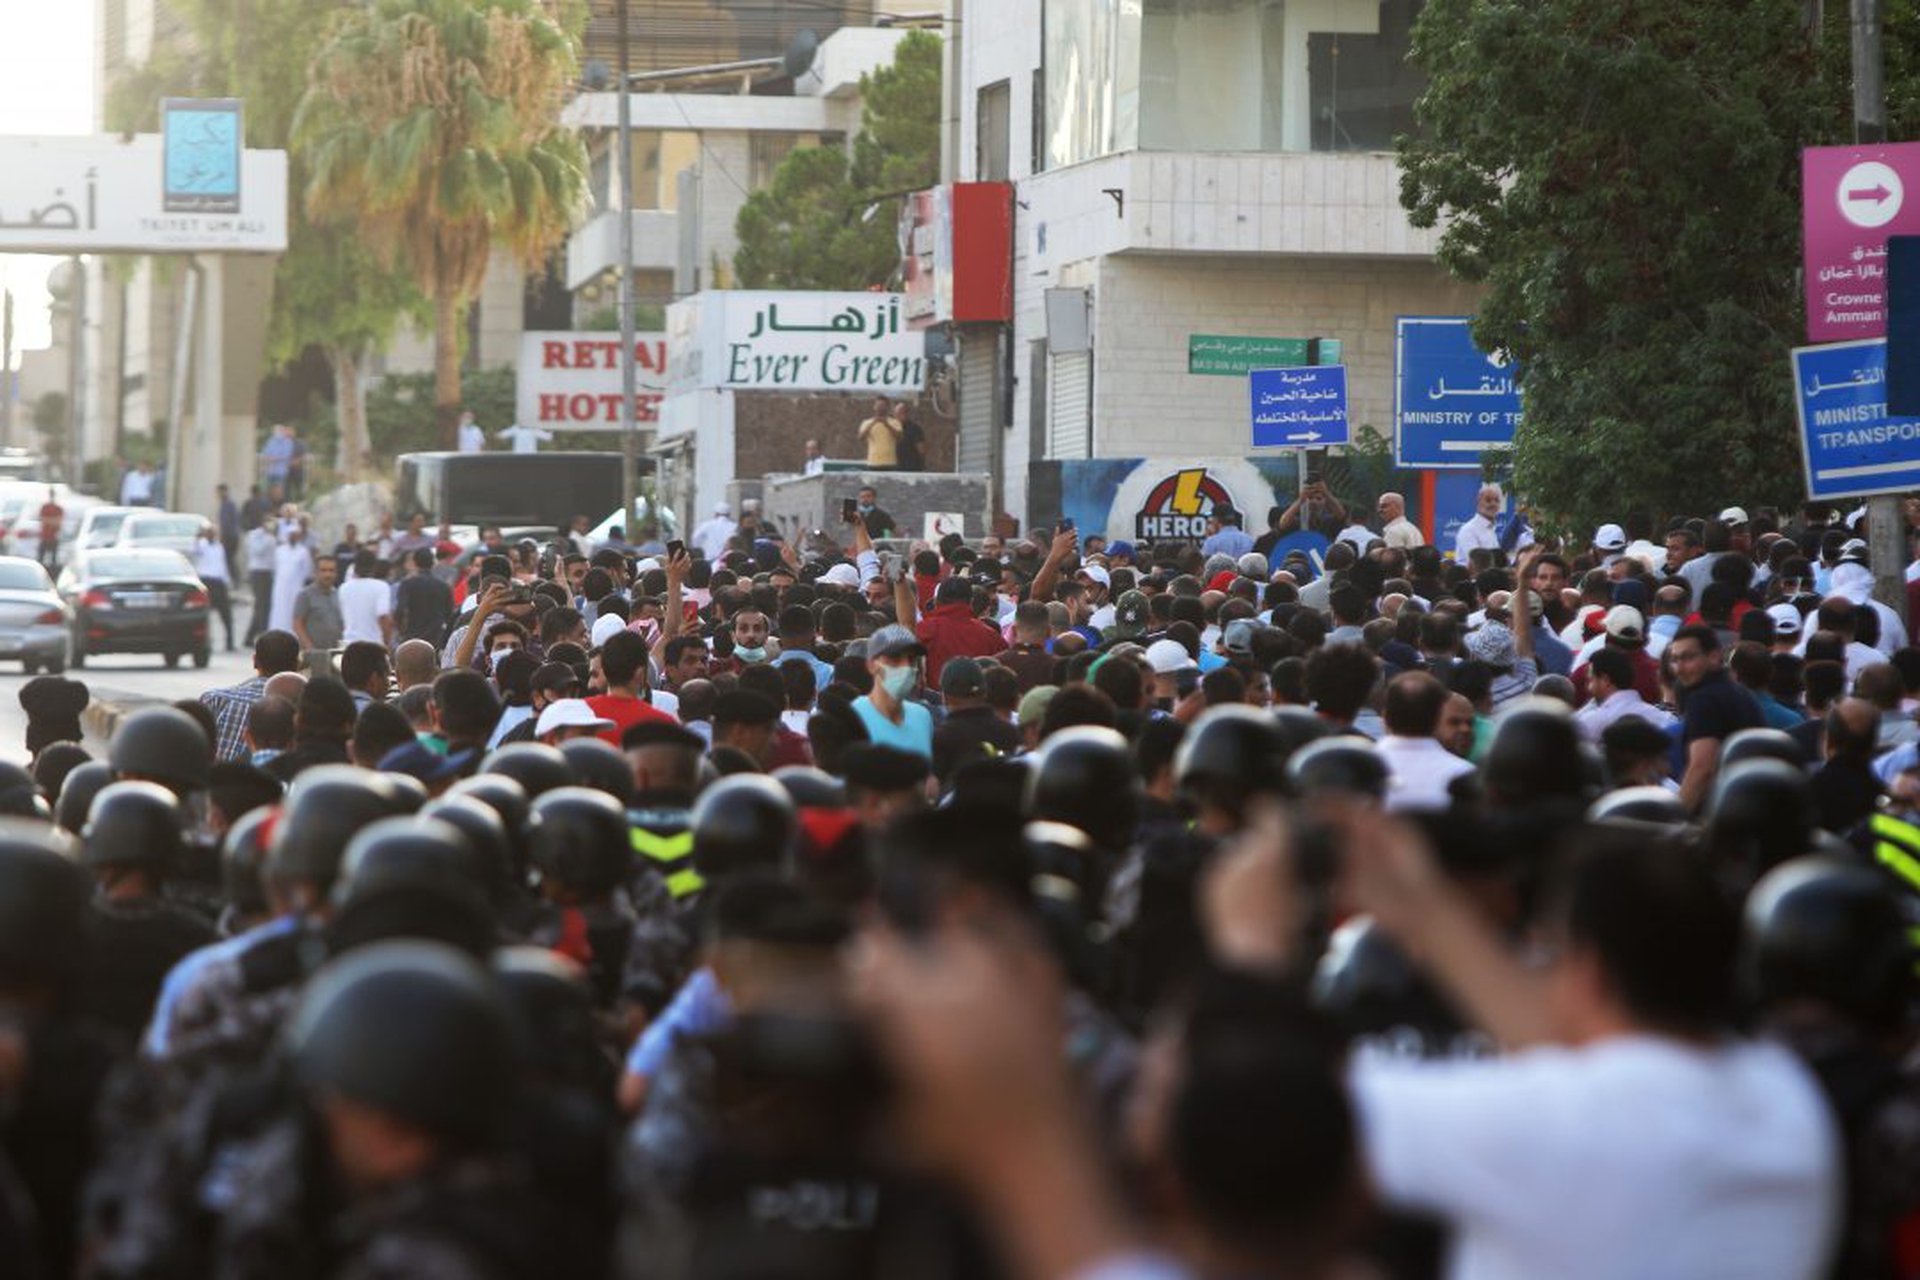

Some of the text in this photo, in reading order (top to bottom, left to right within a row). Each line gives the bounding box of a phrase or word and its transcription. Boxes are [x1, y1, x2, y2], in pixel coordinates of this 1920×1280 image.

[1850, 244, 1888, 261] ندق
[1826, 292, 1882, 305] Crowne
[748, 296, 898, 339] أزهار
[1826, 310, 1881, 323] Amman
[542, 340, 667, 375] RETAJ
[726, 343, 922, 385] Ever Green
[1280, 372, 1317, 385] مدرسة
[1428, 375, 1513, 399] النقل
[1805, 366, 1886, 397] النقل
[1260, 388, 1338, 404] ضاحية الحسين
[1403, 411, 1473, 425] MINISTRY
[1478, 411, 1499, 425] OF
[1142, 516, 1207, 538] HERO
[748, 1181, 880, 1231] POLI
